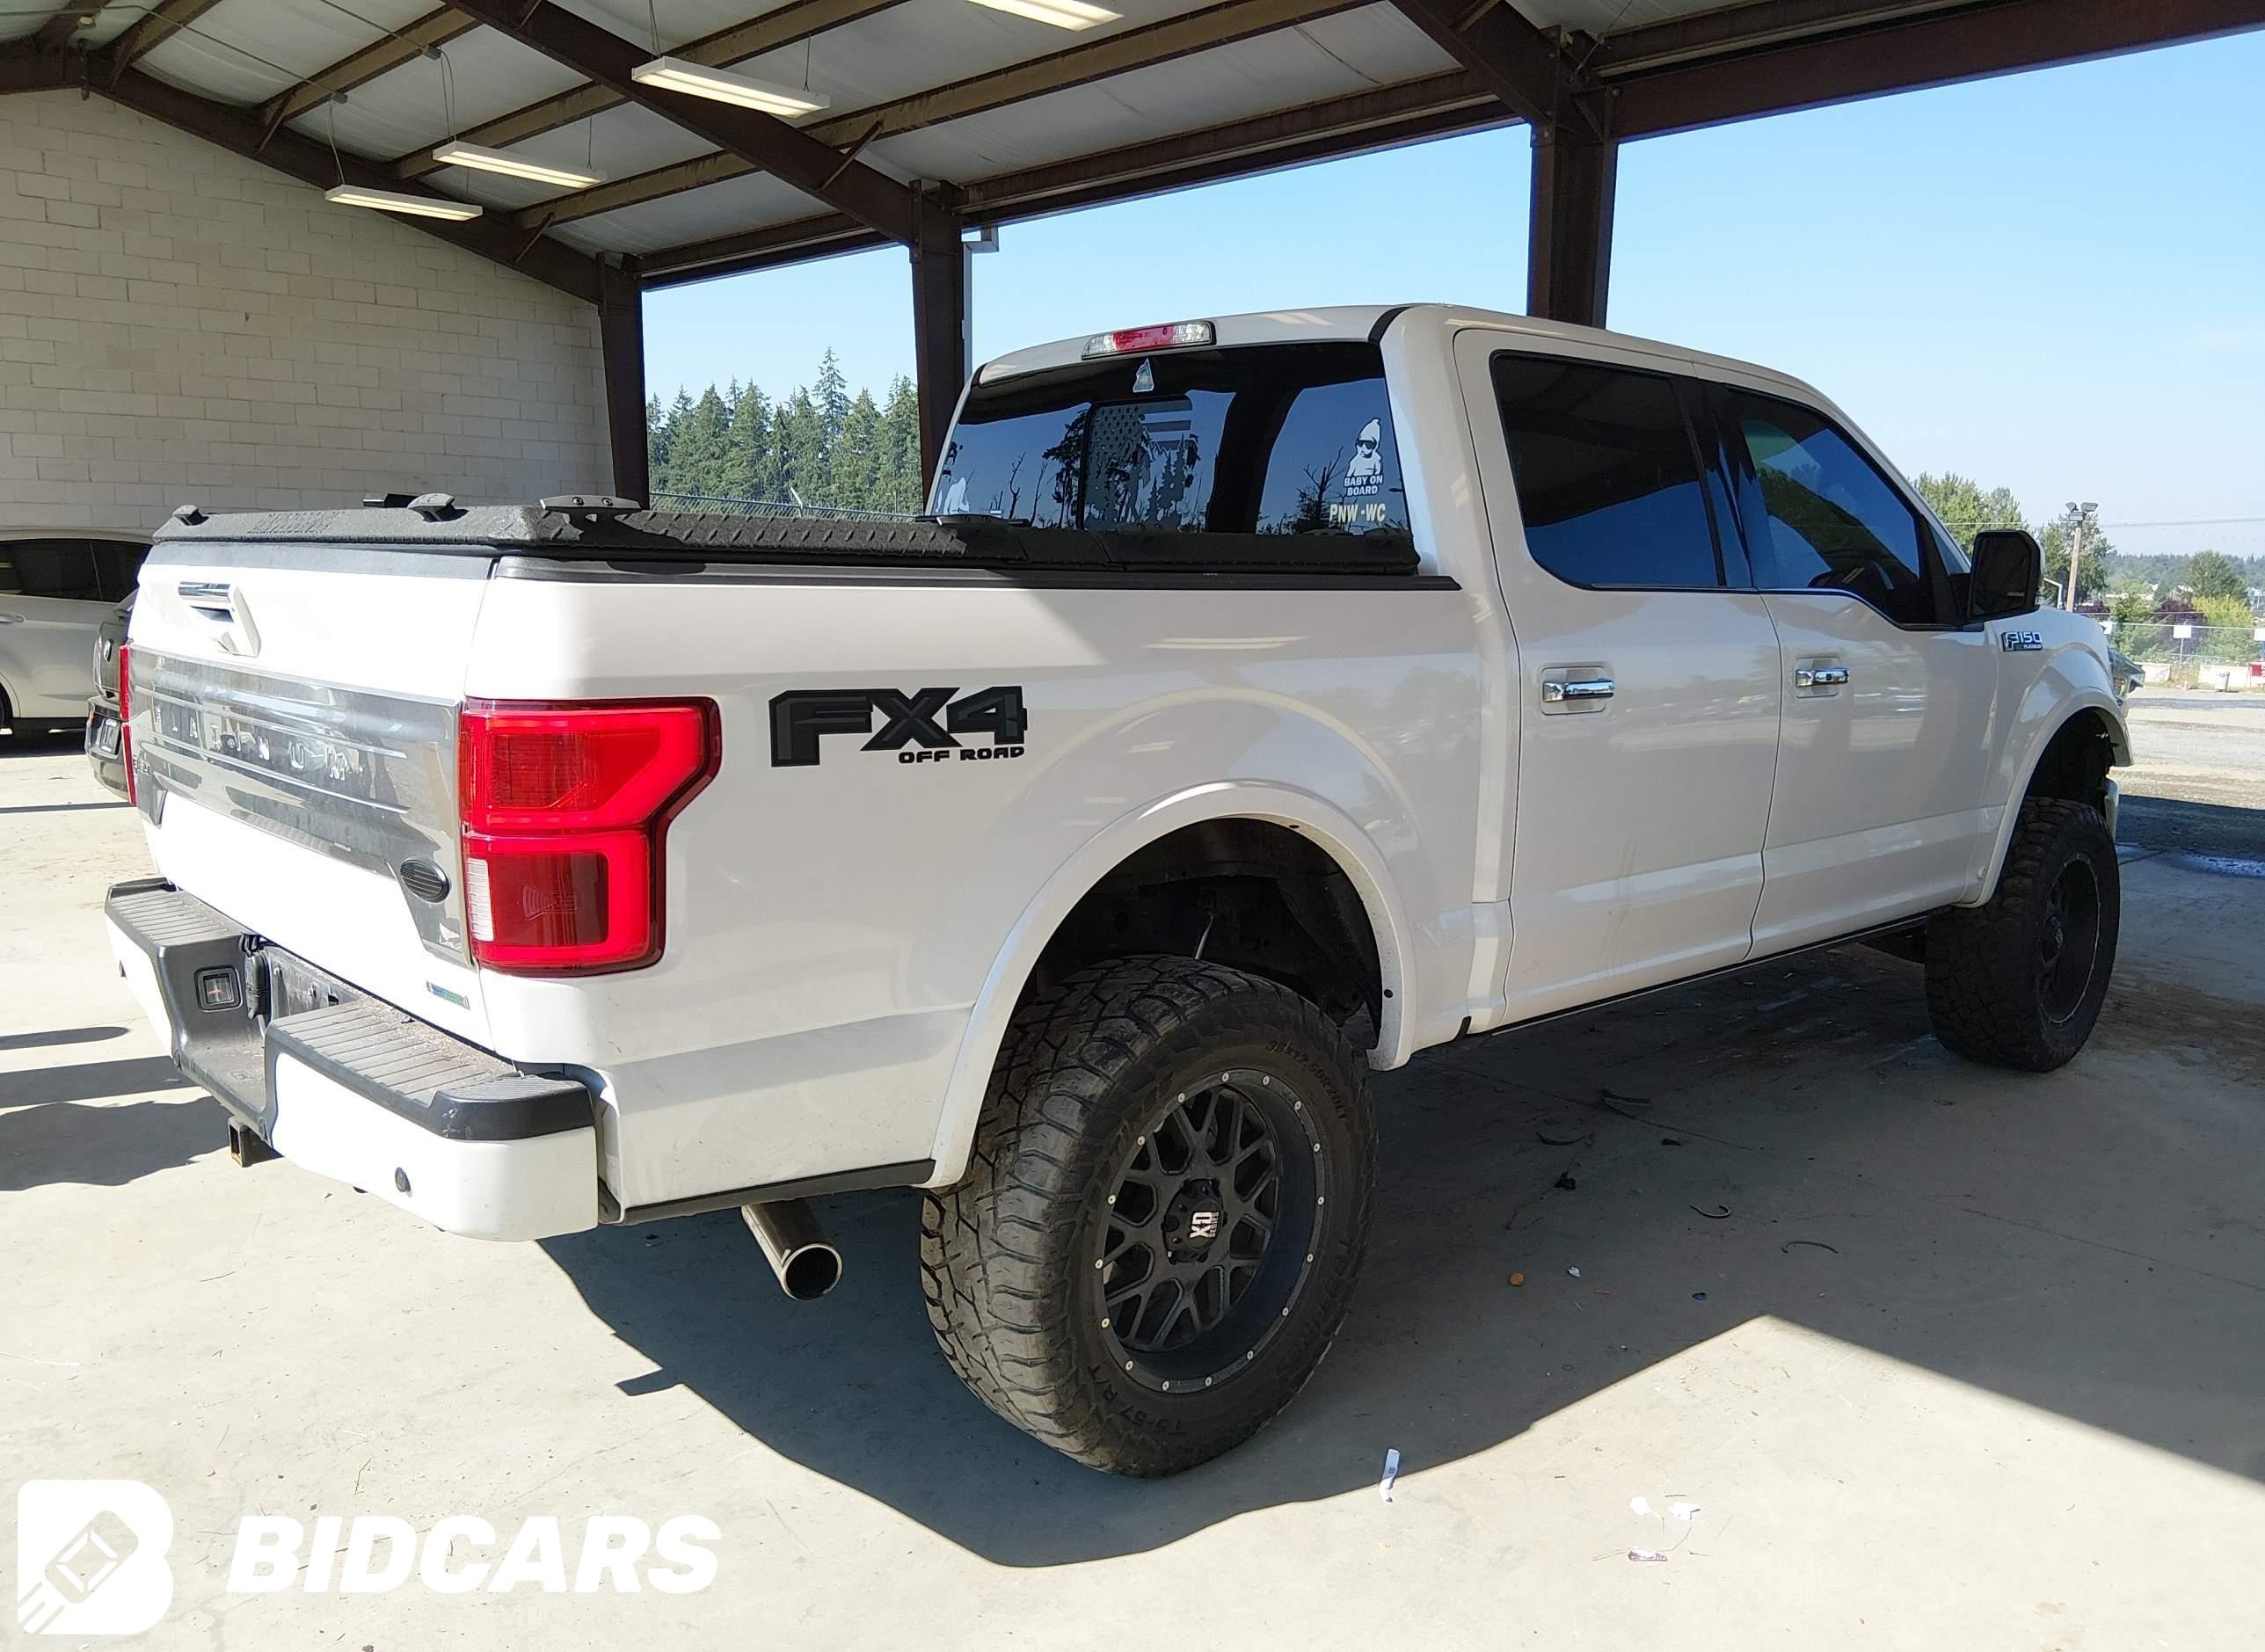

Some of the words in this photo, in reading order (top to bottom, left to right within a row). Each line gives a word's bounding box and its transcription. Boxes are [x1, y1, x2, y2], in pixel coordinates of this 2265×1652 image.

[1344, 476, 1368, 487] BABY
[1369, 475, 1383, 484] ON
[1347, 485, 1378, 496] BOARD
[768, 686, 1028, 768] FX4
[898, 749, 950, 763] OFF
[959, 746, 1025, 761] ROAD
[1189, 1211, 1213, 1239] XD
